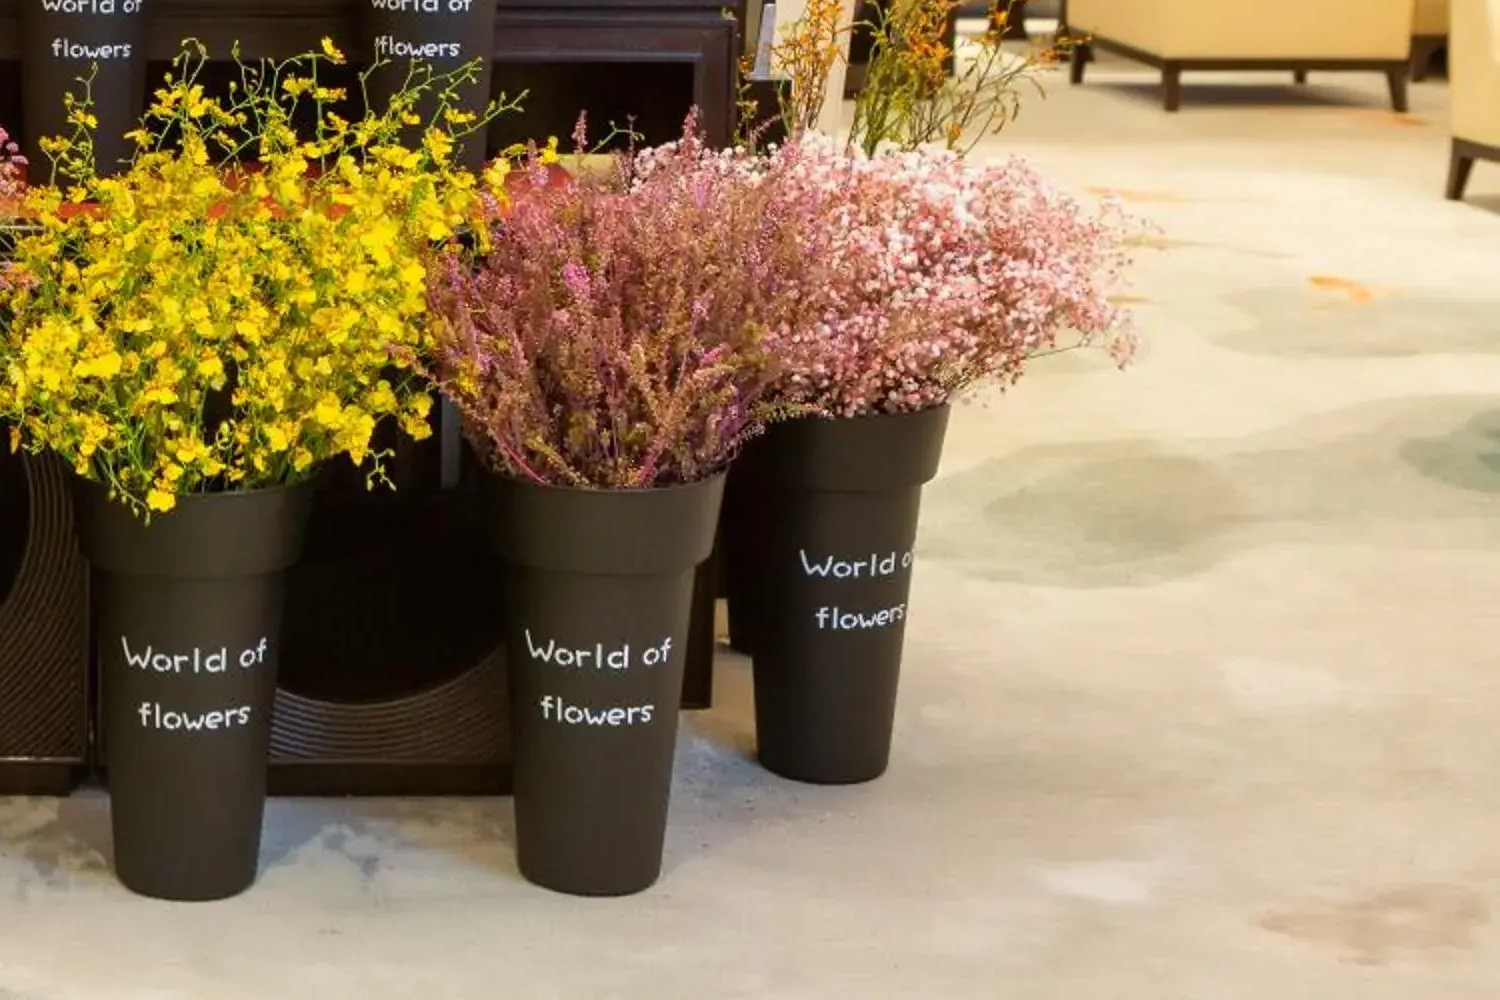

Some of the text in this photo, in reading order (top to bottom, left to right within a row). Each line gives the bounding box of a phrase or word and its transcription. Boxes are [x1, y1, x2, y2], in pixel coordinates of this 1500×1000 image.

[51, 37, 132, 59] flowers
[379, 35, 461, 57] flowers
[800, 549, 915, 578] World o
[121, 634, 267, 674] World of
[525, 627, 672, 669] World of
[138, 701, 251, 731] flowers
[540, 695, 655, 726] flowers
